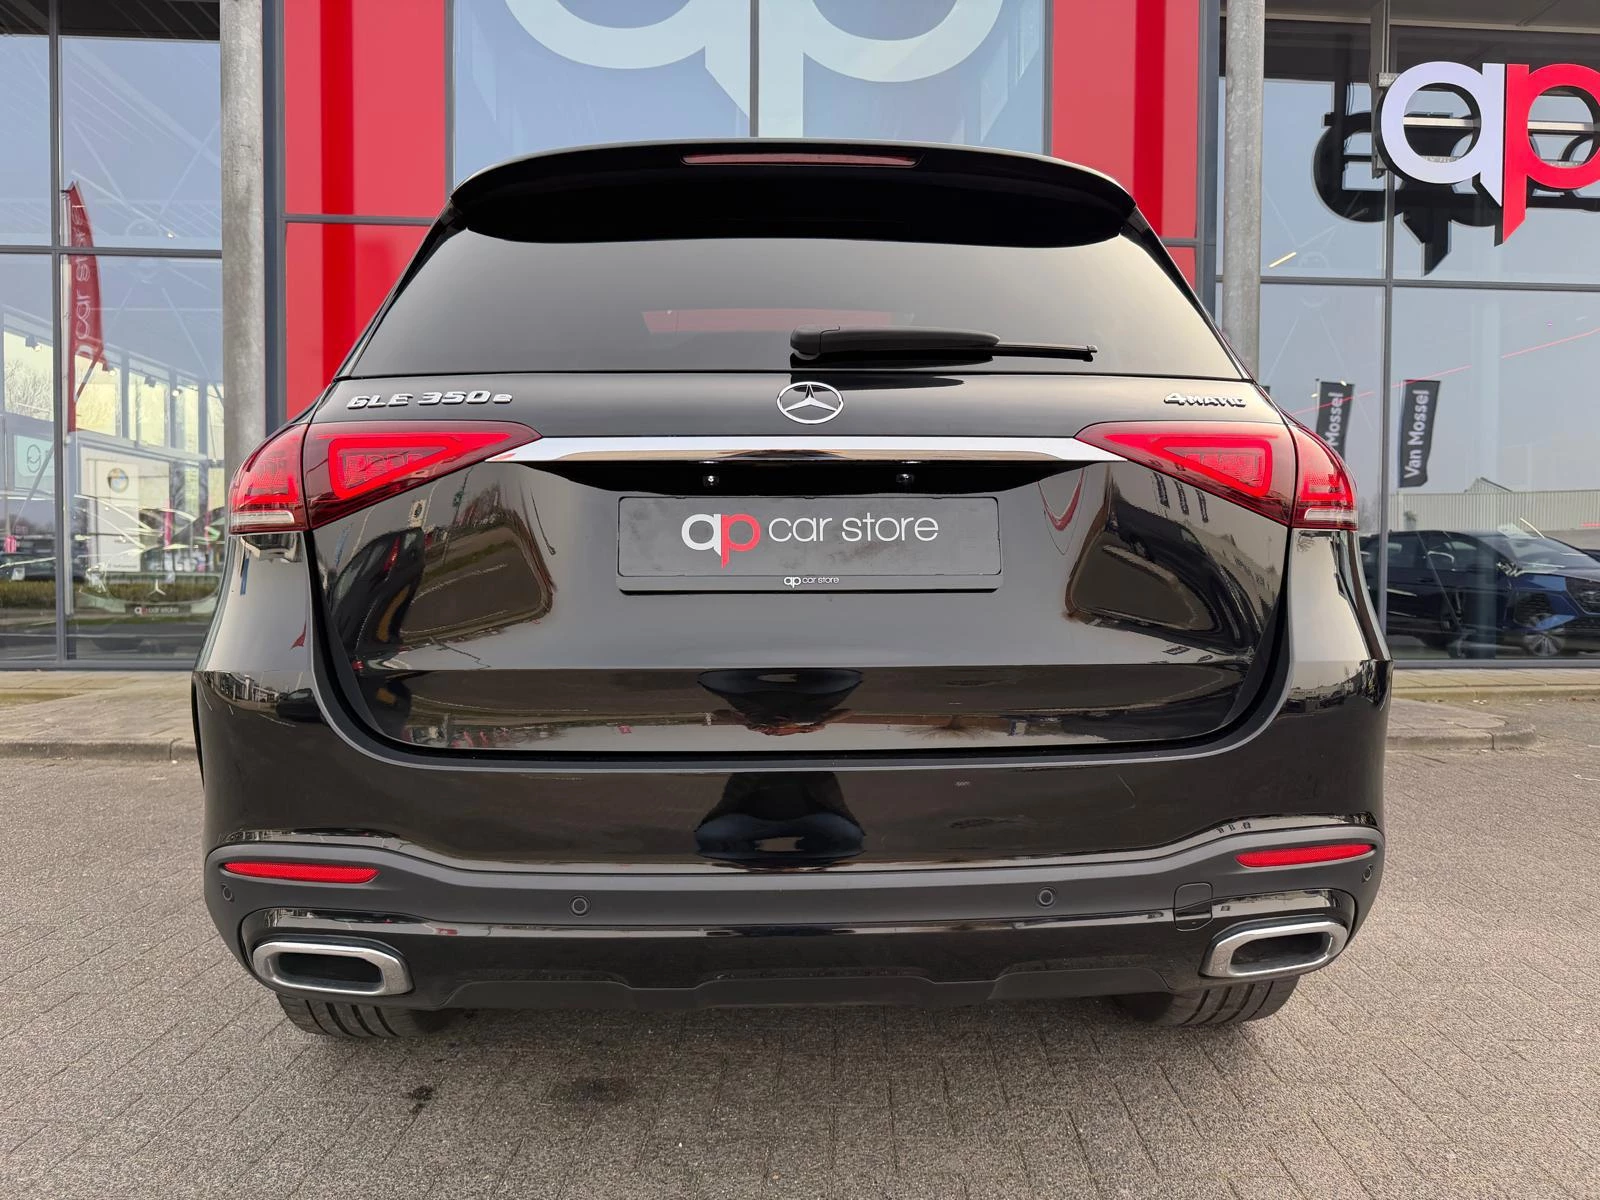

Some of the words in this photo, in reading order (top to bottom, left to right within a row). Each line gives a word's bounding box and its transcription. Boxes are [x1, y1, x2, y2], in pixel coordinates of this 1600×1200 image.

[346, 393, 414, 410] GLE
[1163, 392, 1247, 408] 4MATIC
[1325, 392, 1344, 447] Mossel
[1407, 389, 1430, 446] Mossel
[1404, 449, 1422, 479] Van
[768, 517, 833, 542] car
[841, 512, 939, 542] store
[817, 576, 840, 584] store
